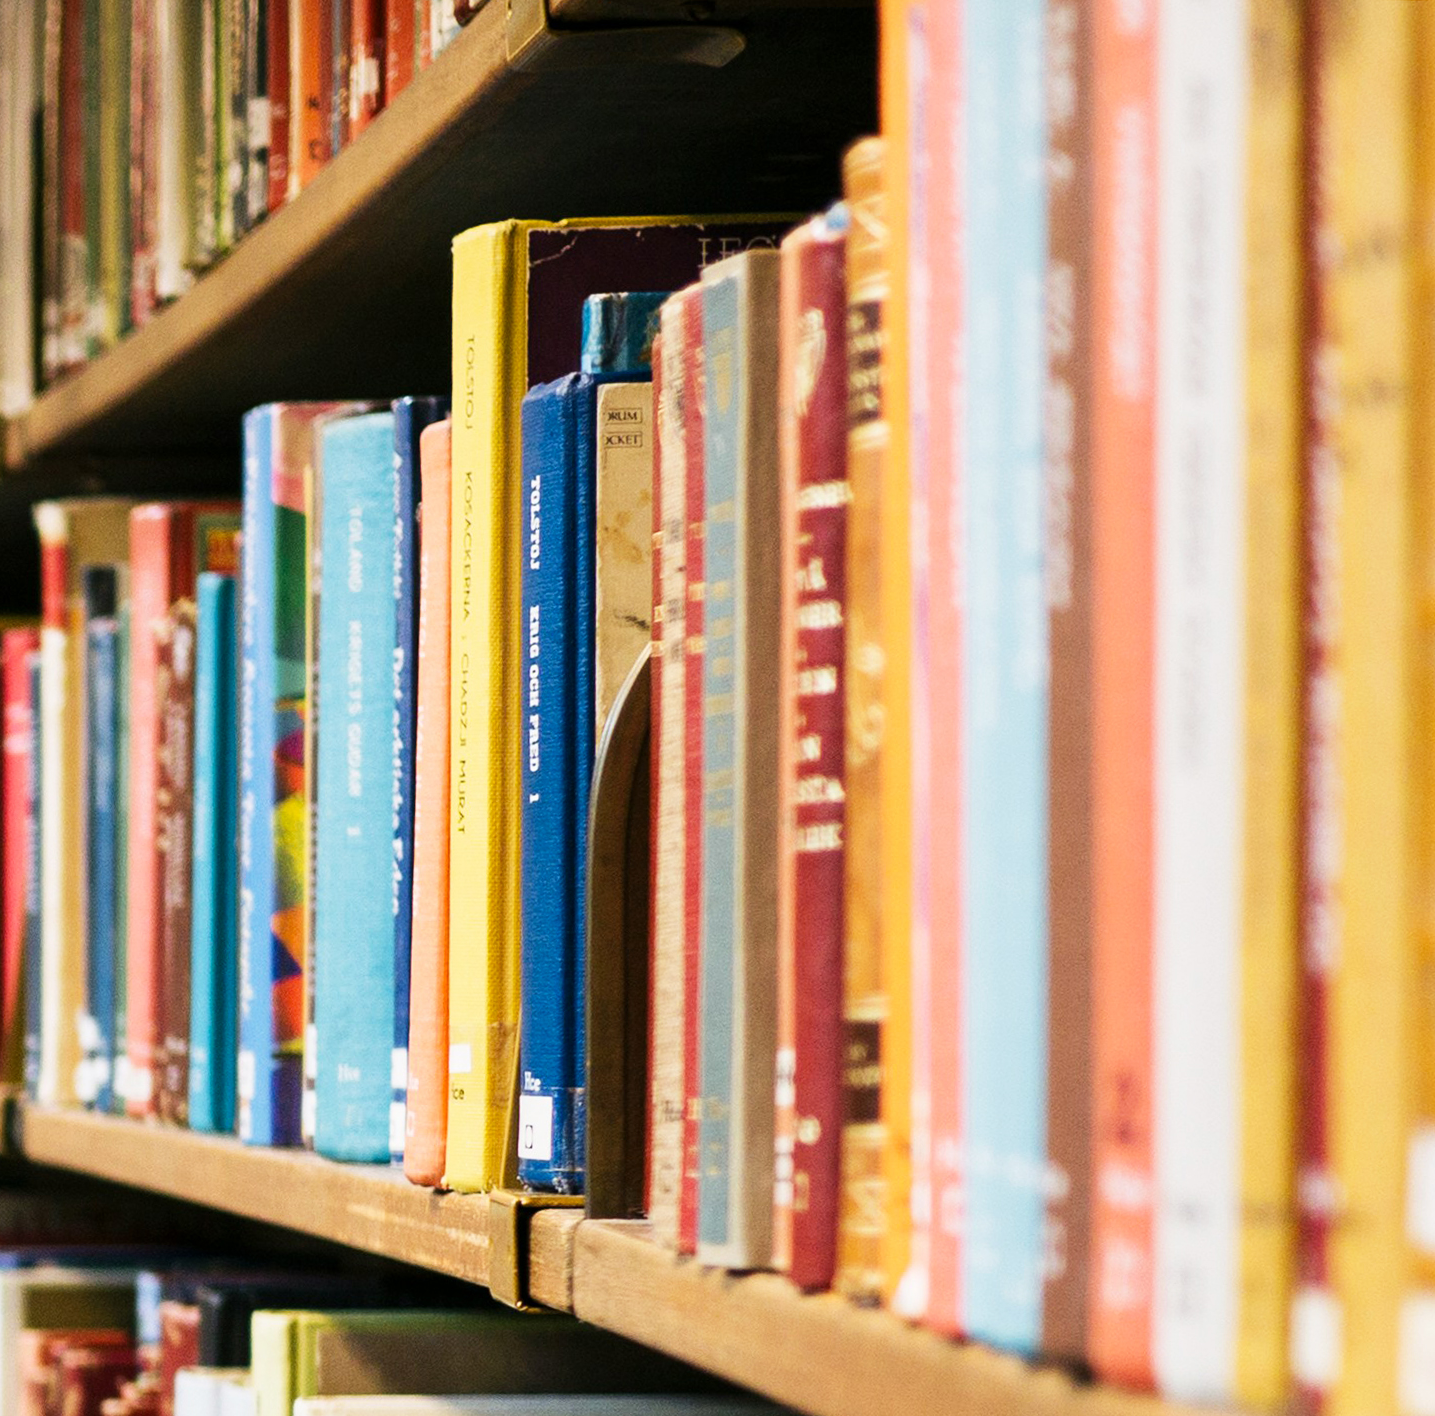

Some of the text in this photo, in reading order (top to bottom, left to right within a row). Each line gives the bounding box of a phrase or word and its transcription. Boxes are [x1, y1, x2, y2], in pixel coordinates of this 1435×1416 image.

[464, 334, 476, 430] TOLSTOJ
[462, 471, 474, 622] KOSACKERNA
[528, 475, 541, 804] TOLSTOJ KRIG OCH FRED 1
[457, 760, 466, 836] MURAT
[523, 1070, 541, 1091] Hce
